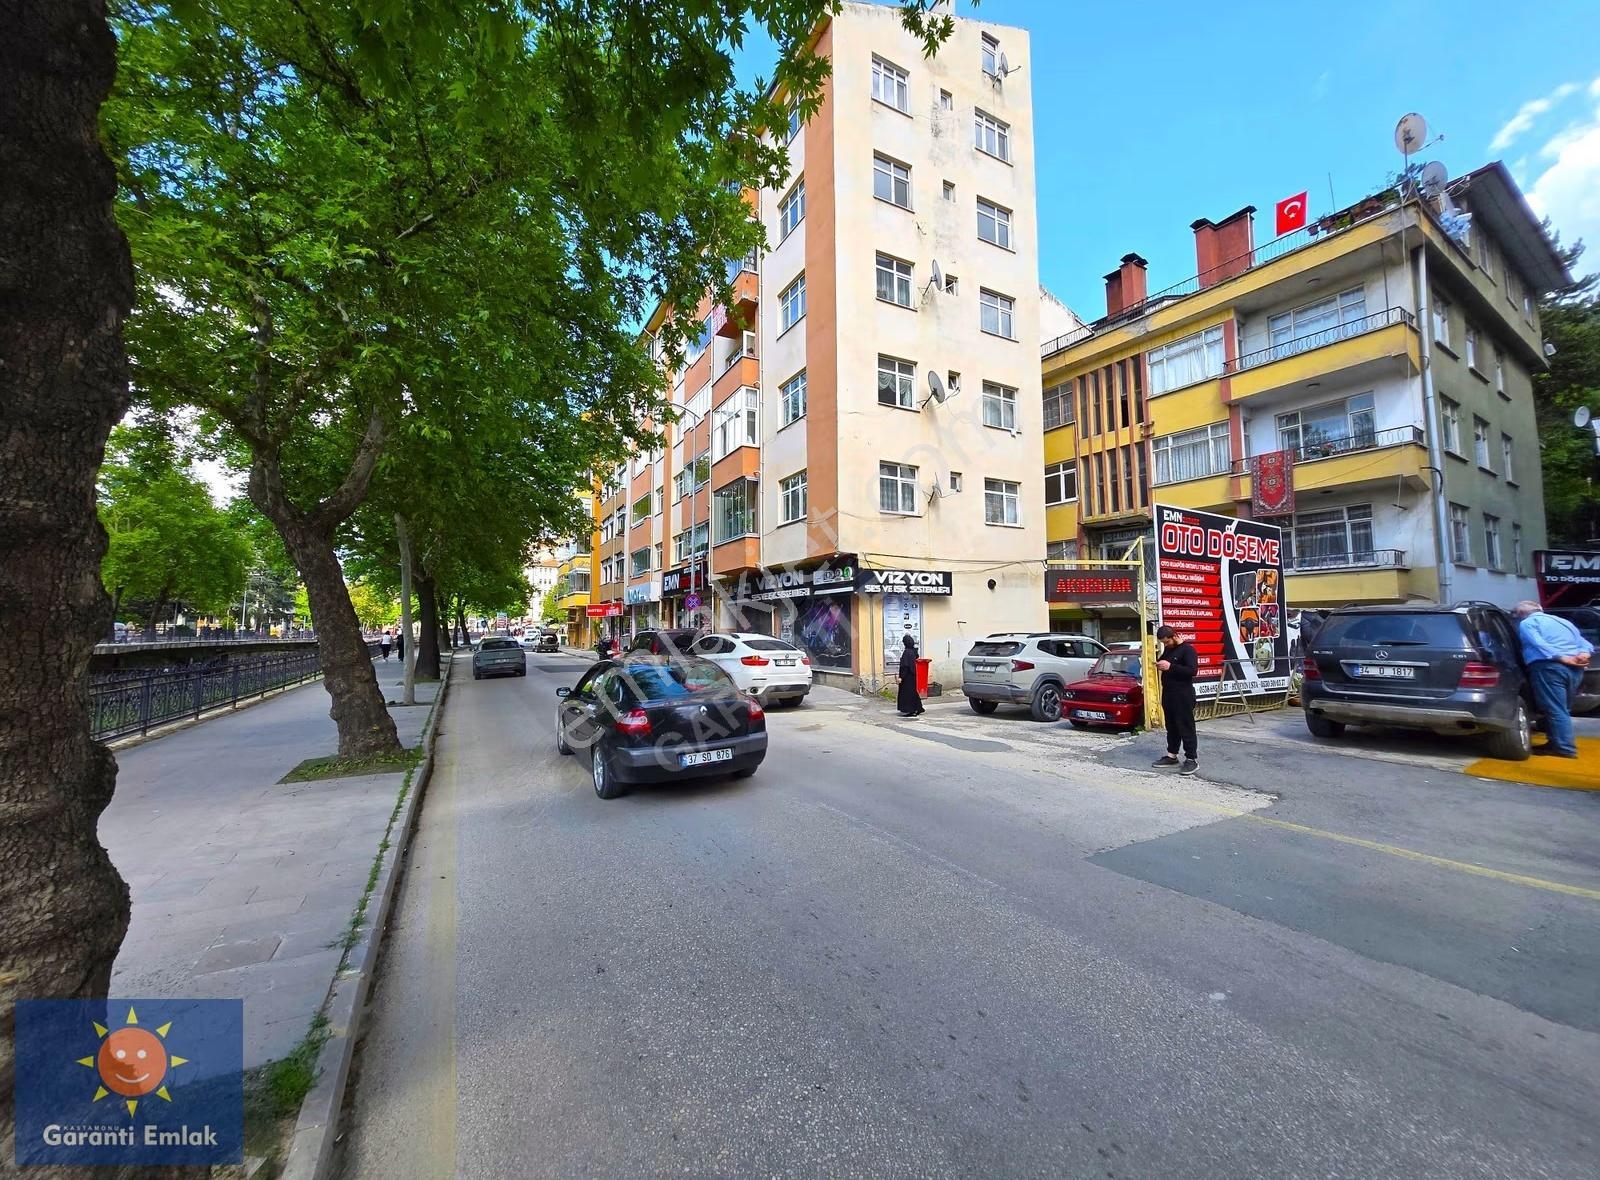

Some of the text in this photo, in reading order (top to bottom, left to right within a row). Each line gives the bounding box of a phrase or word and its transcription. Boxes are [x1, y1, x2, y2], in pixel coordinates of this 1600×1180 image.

[1163, 510, 1182, 522] EMN
[1162, 522, 1280, 565] OTO DÖŞEME
[664, 573, 680, 591] EMN
[874, 570, 944, 585] VİZYON
[1056, 578, 1132, 592] AKSESUAR
[1392, 667, 1413, 676] 1817
[688, 754, 697, 764] 37
[716, 749, 730, 760] 876
